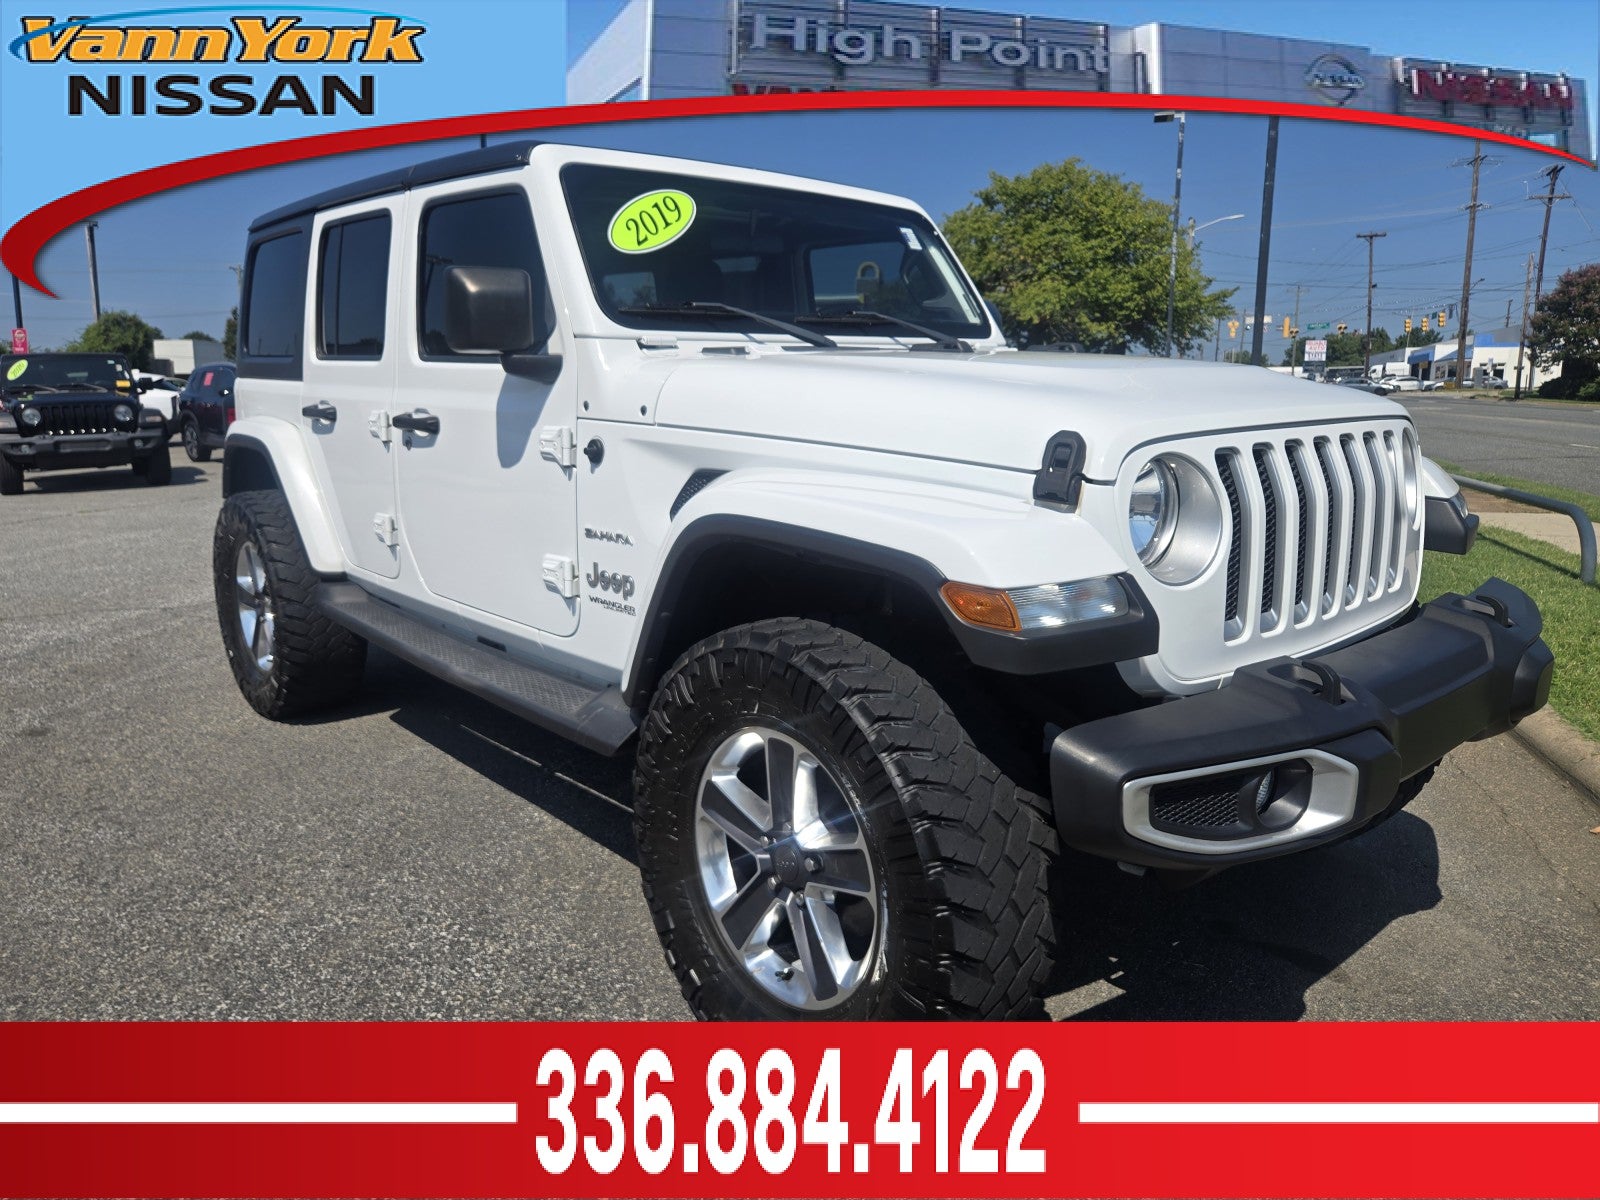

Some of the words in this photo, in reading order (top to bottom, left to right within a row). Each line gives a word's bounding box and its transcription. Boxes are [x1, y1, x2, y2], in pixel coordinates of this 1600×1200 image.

[750, 13, 921, 66] High
[950, 29, 1110, 73] Point
[625, 195, 682, 247] 2019
[584, 527, 633, 546] SAHARA
[586, 561, 635, 601] Jeep
[588, 594, 635, 612] WRANGLER
